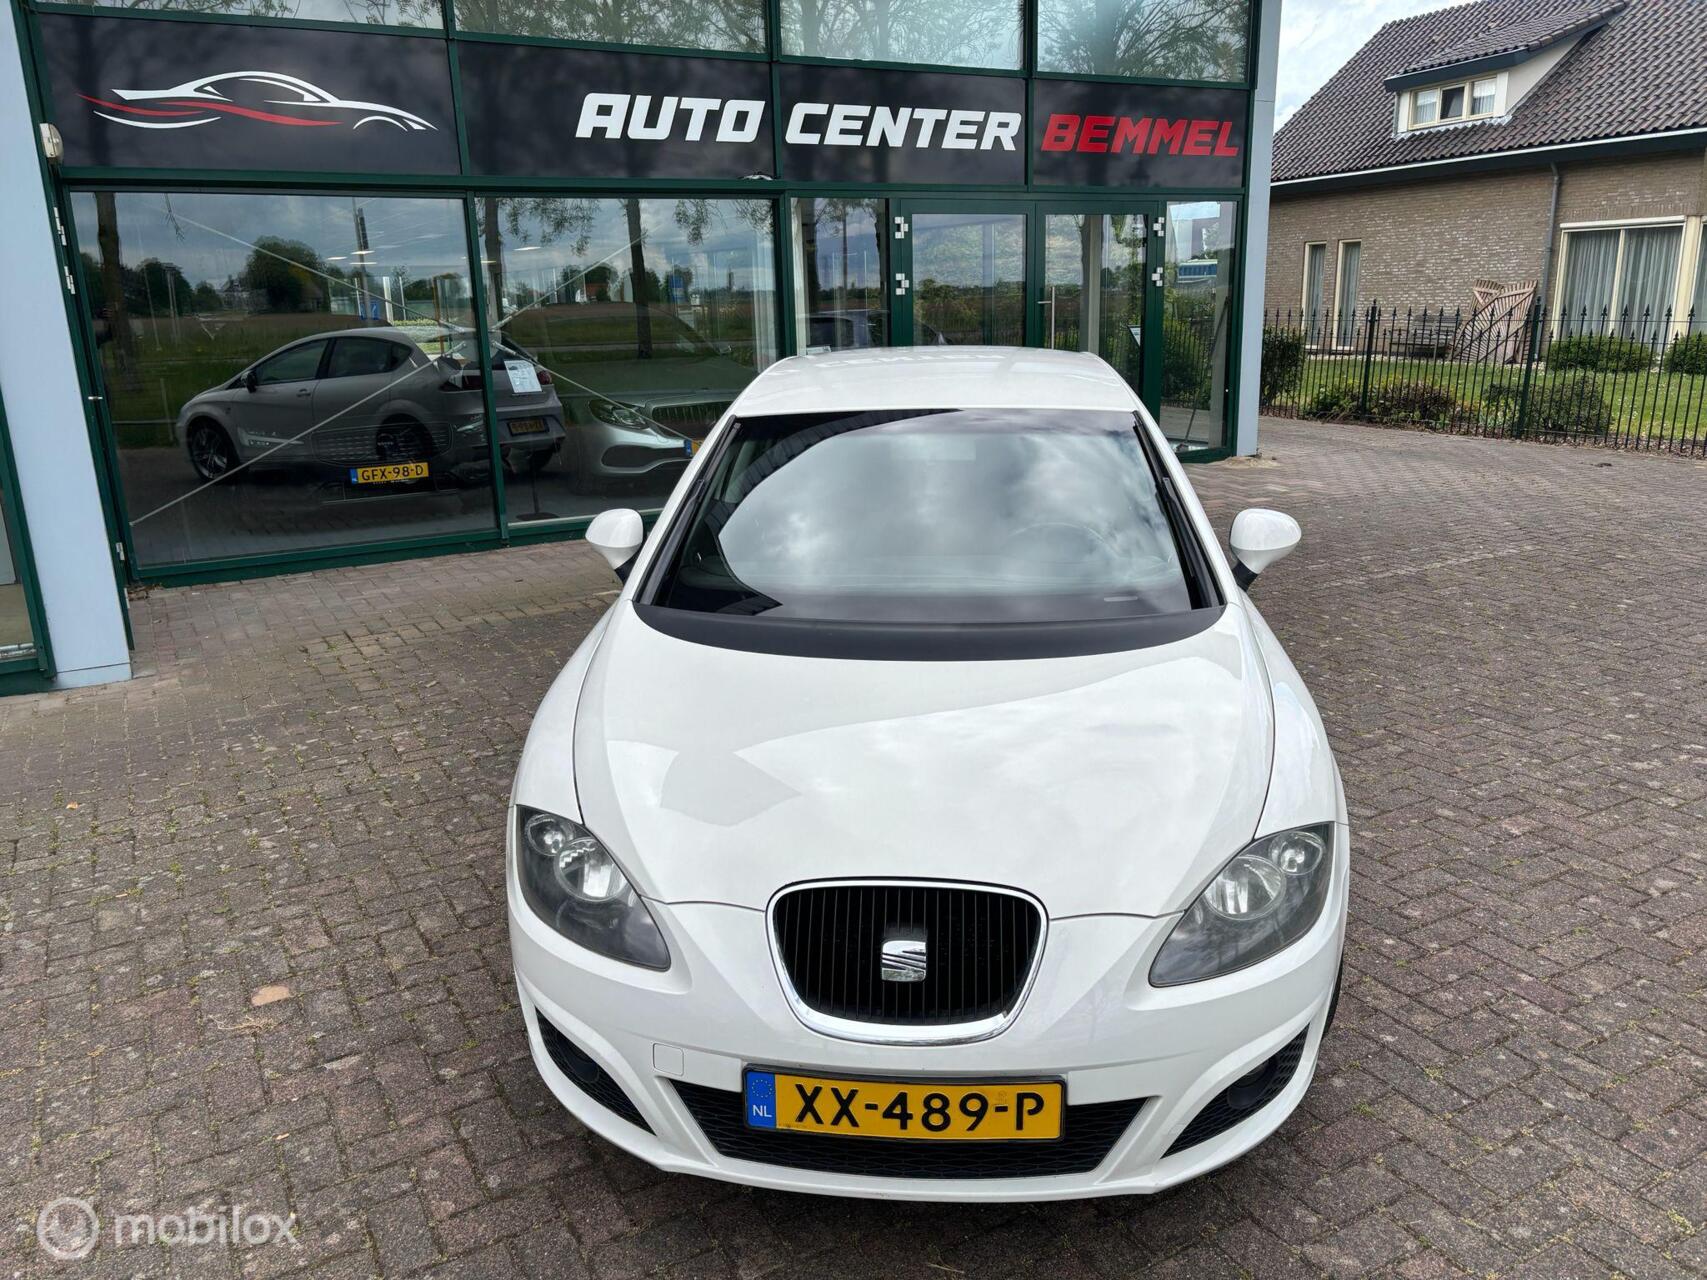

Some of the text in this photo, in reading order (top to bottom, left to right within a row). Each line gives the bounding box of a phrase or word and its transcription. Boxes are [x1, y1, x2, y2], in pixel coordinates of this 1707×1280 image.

[575, 93, 1239, 157] AUTO CENTER BEMMEL
[361, 465, 424, 481] GFX-98-D
[752, 1083, 1045, 1132] NL XX-489-P
